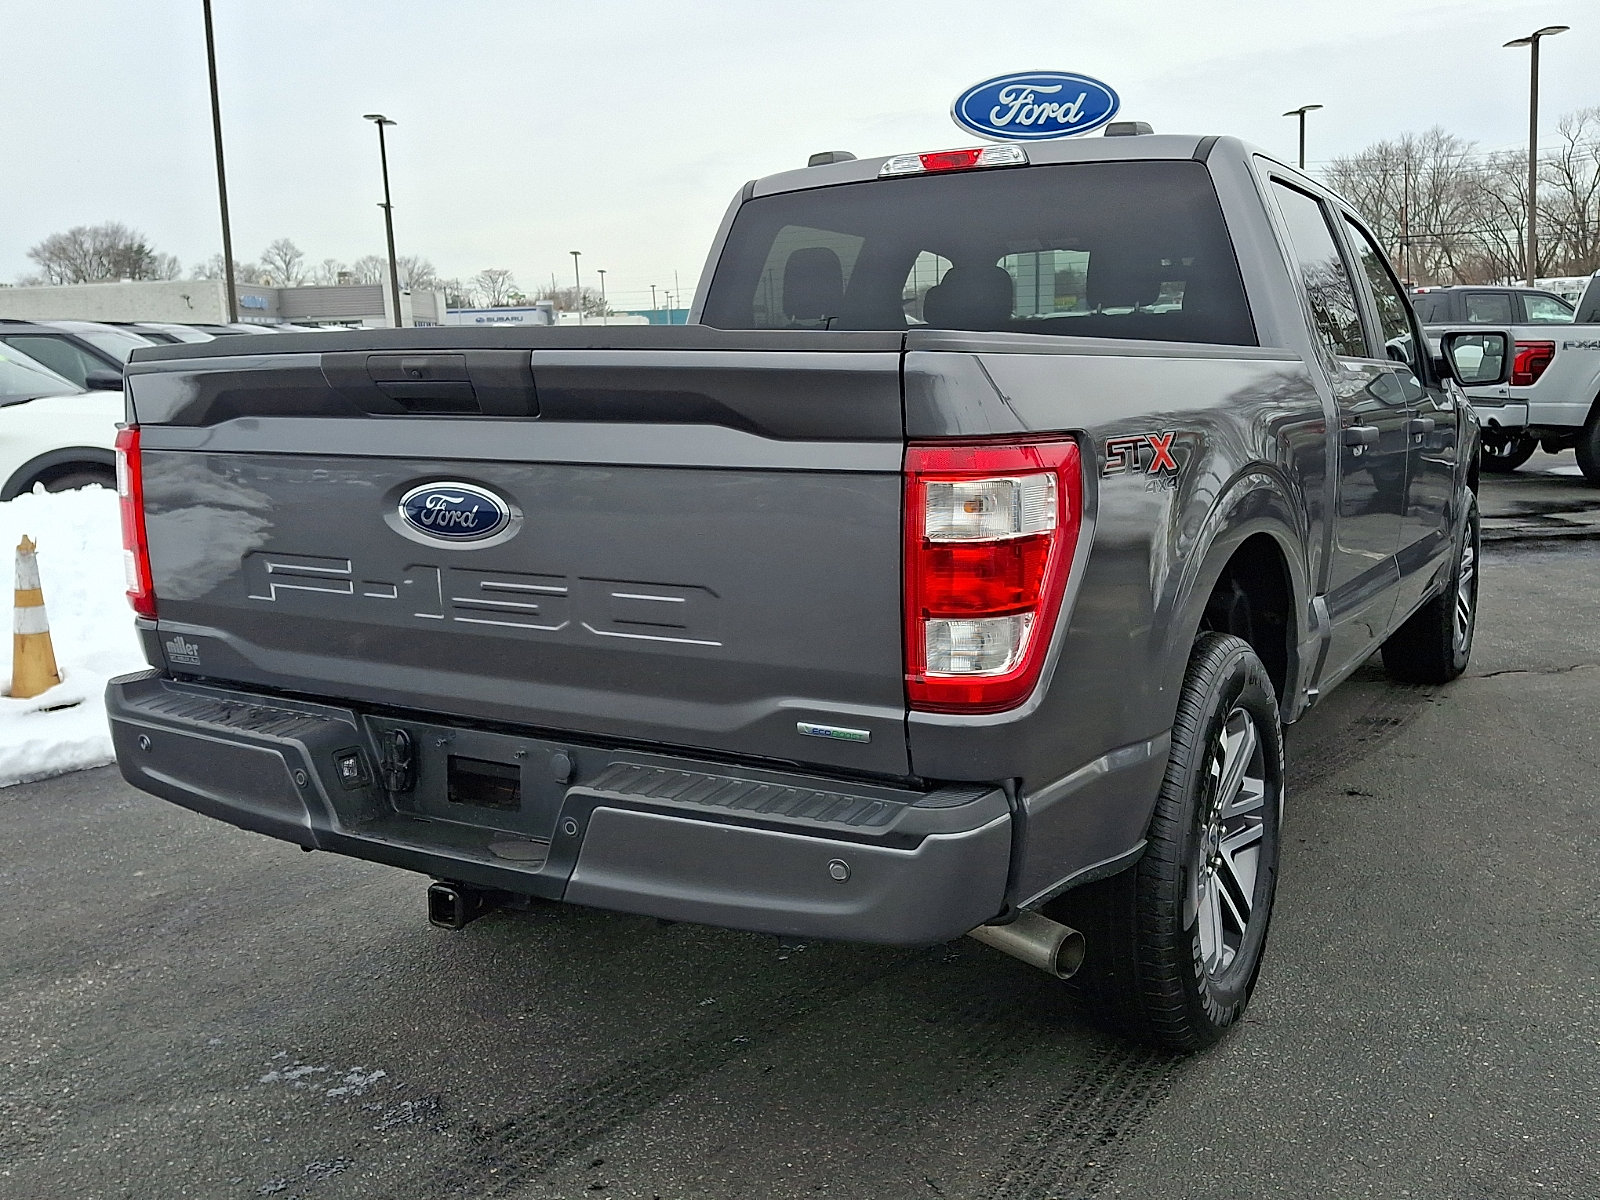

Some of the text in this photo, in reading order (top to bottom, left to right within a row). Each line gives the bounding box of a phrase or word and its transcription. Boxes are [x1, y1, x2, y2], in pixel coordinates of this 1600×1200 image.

[990, 84, 1087, 126] Ford
[1102, 430, 1180, 477] STX
[421, 494, 479, 528] Ford
[243, 550, 722, 646] F-150
[166, 635, 198, 656] miller
